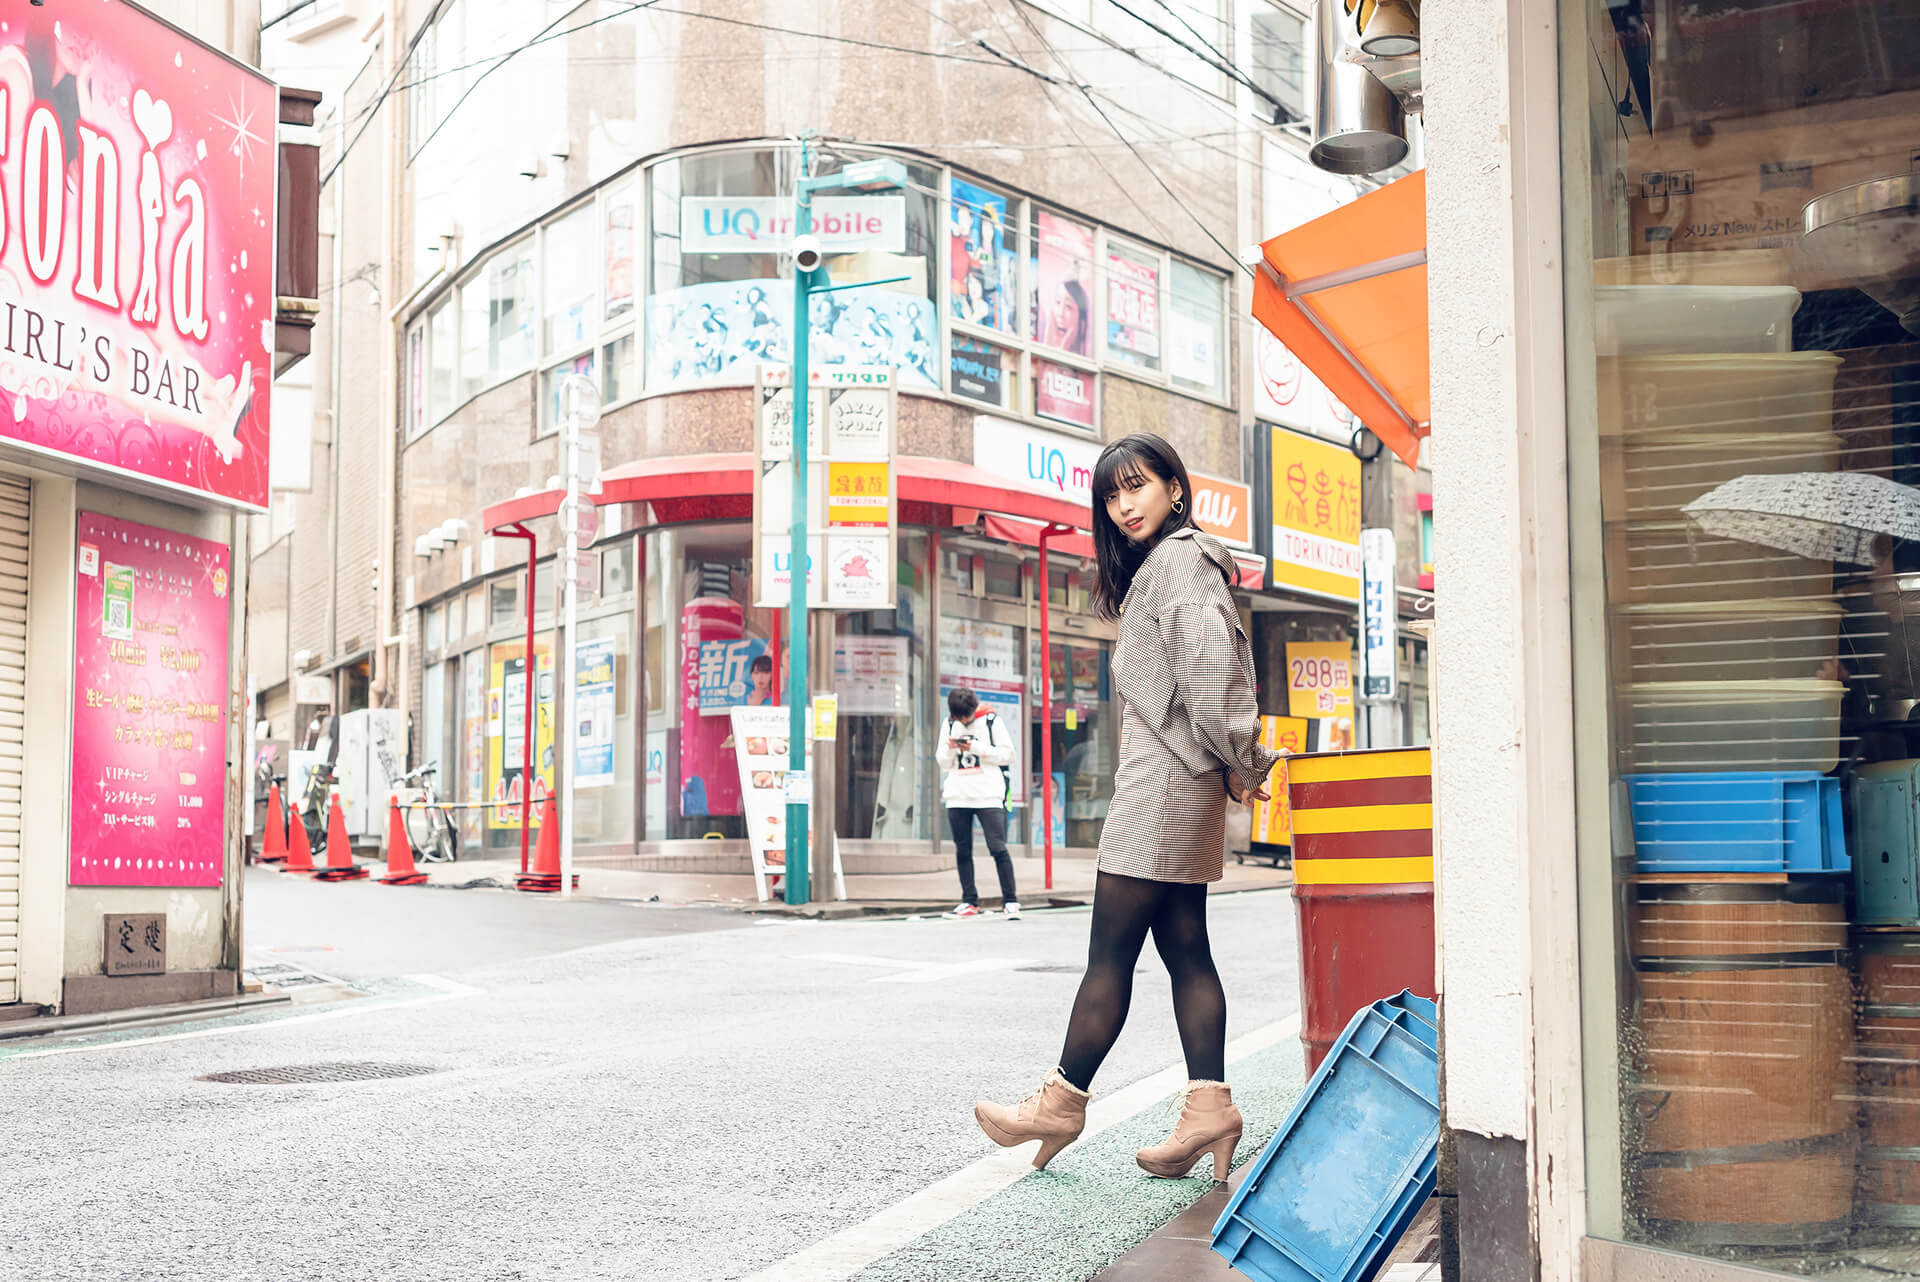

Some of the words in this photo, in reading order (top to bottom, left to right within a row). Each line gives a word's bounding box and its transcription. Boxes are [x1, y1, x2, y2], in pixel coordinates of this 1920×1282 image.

[0, 88, 209, 341] onia
[703, 208, 760, 240] UQ
[1723, 221, 1757, 234] New
[4, 303, 111, 383] IRL'S
[130, 348, 202, 415] BAR
[1027, 442, 1066, 493] UQ
[1194, 489, 1237, 528] au
[1285, 534, 1361, 573] TORIKIZOKU
[134, 567, 193, 598] YSTEM
[110, 640, 147, 667] 40min
[699, 640, 751, 688] 新
[1290, 658, 1350, 690] 298円
